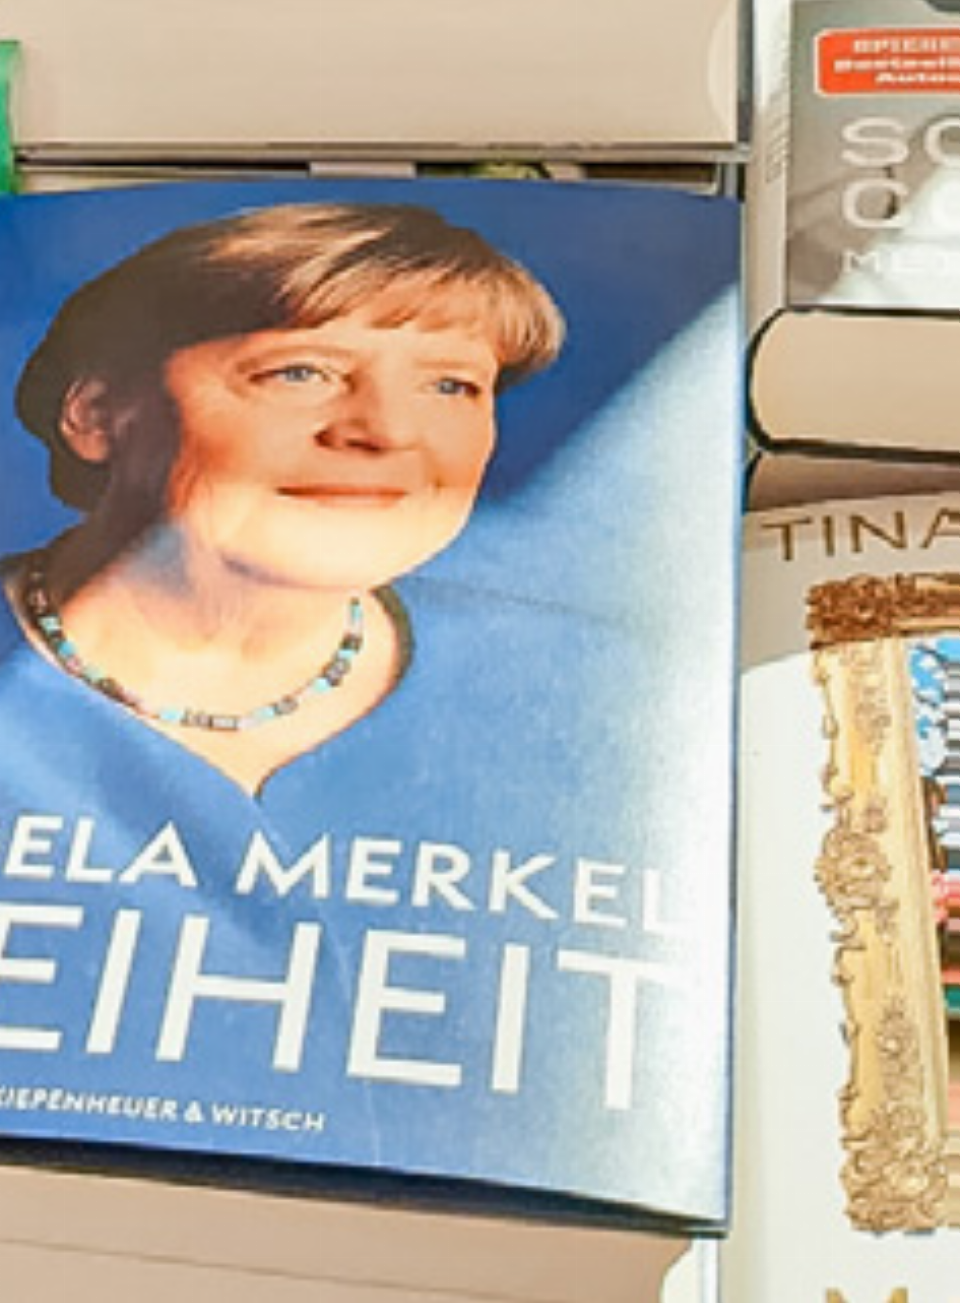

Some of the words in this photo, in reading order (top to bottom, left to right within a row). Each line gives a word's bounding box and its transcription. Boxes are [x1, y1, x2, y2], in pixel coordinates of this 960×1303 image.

[234, 829, 695, 941] MERKEL
[183, 1101, 204, 1124] &
[211, 1101, 326, 1133] WITSCH
